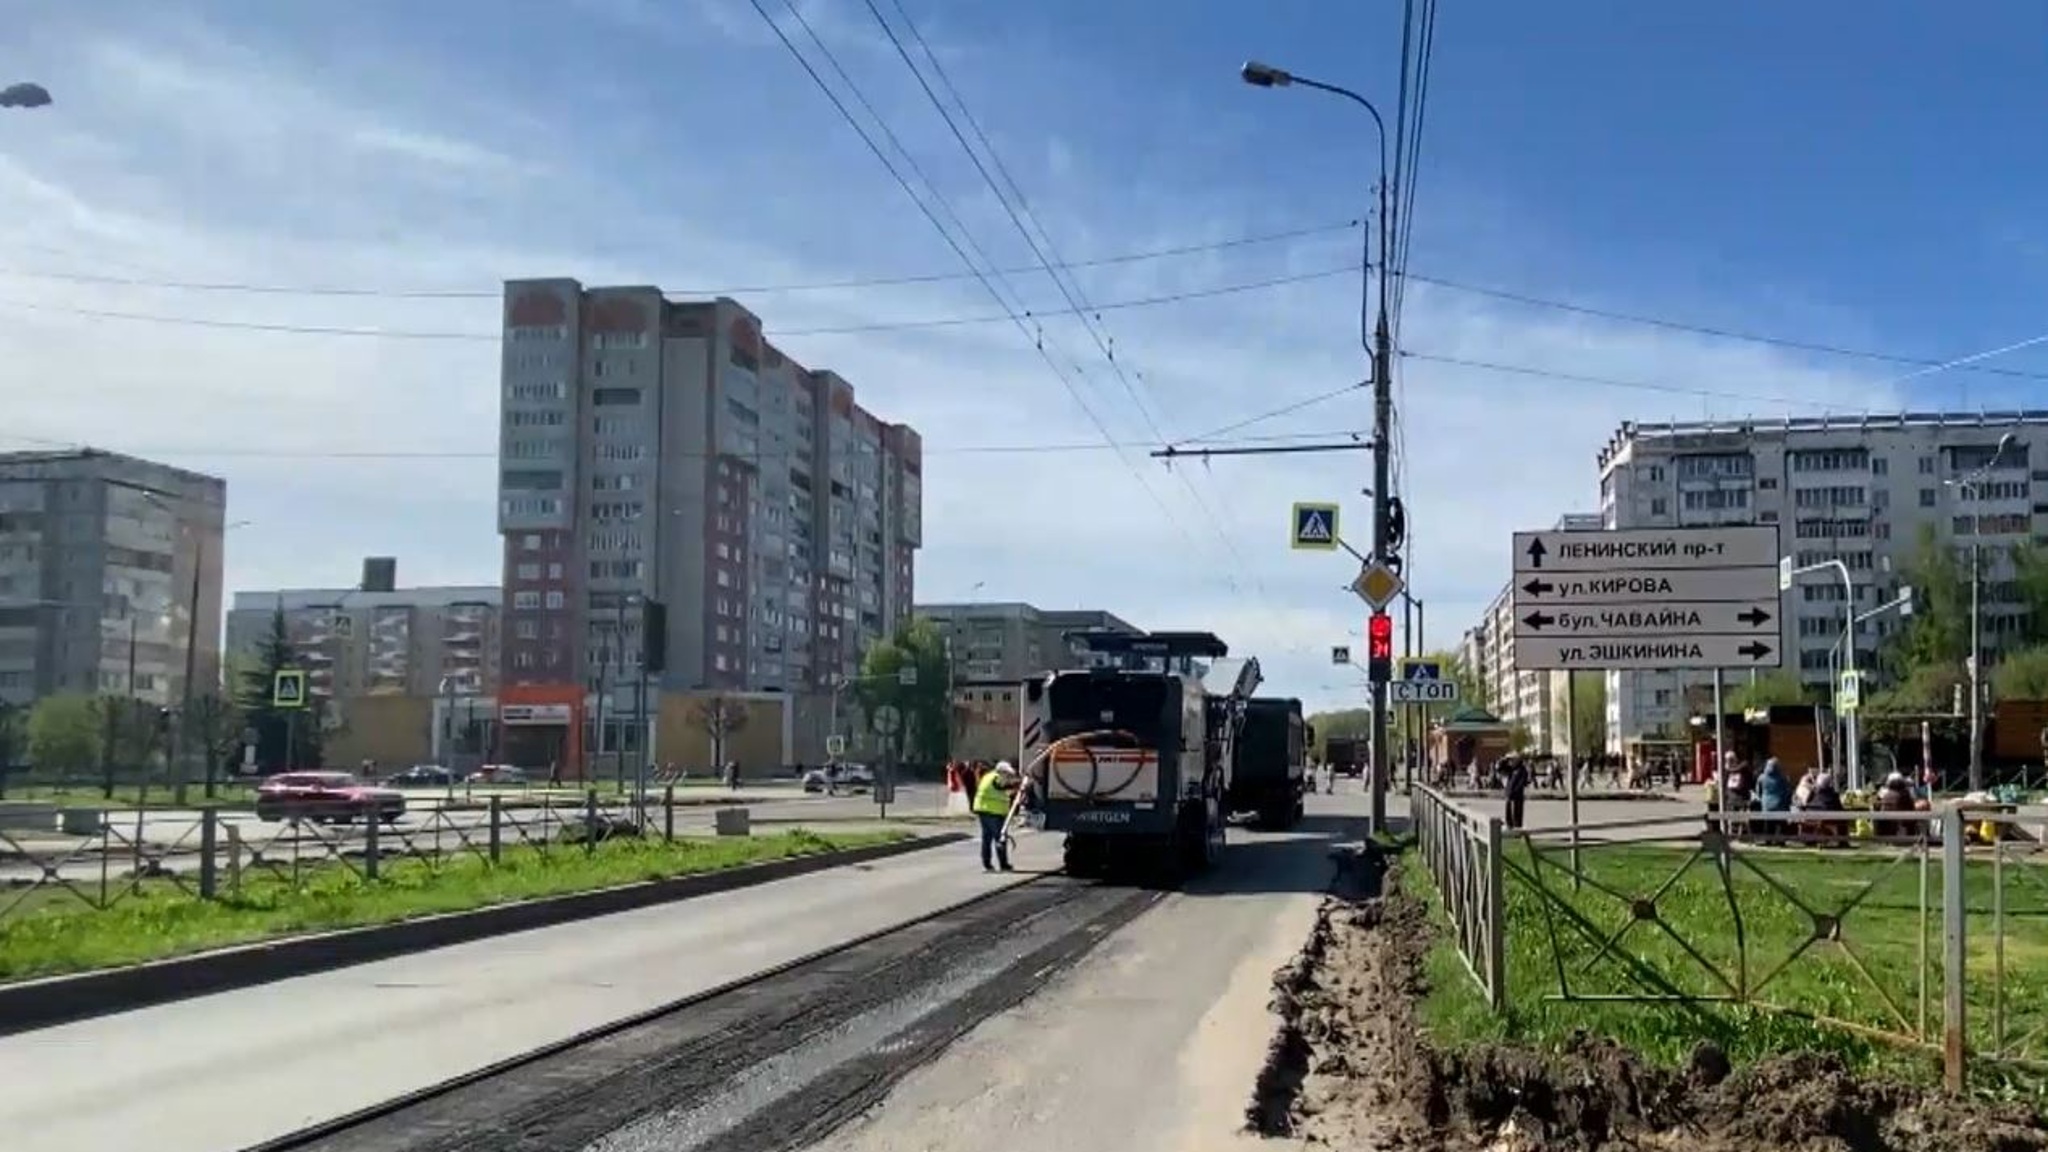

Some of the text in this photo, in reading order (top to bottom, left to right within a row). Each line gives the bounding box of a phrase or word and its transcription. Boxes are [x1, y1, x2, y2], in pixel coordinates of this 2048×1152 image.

[1559, 538, 1725, 559] ЛЕНИНСКИЙ пр-т
[1398, 683, 1454, 698] СТОП
